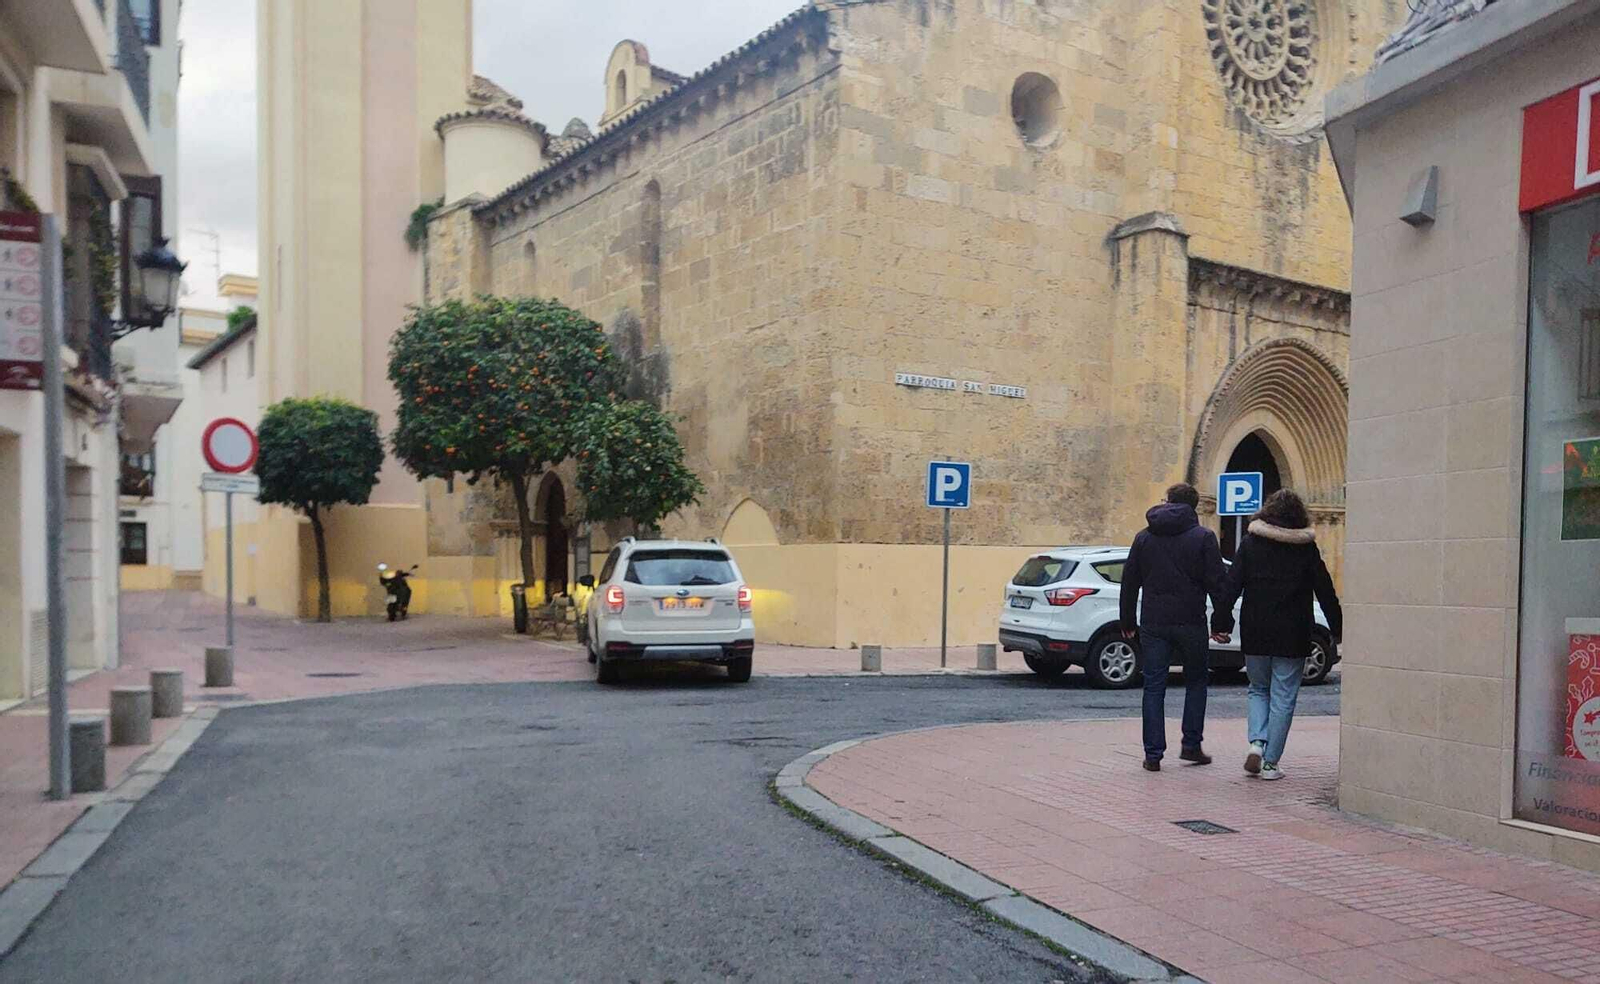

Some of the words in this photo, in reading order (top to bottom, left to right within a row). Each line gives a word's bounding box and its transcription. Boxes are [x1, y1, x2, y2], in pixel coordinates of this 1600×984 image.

[896, 374, 956, 389] PARROQUIA
[964, 381, 982, 391] SAN
[990, 385, 1025, 397] MIGUEL
[935, 467, 962, 501] P
[1225, 480, 1253, 512] P
[1533, 797, 1600, 821] Valoracio
